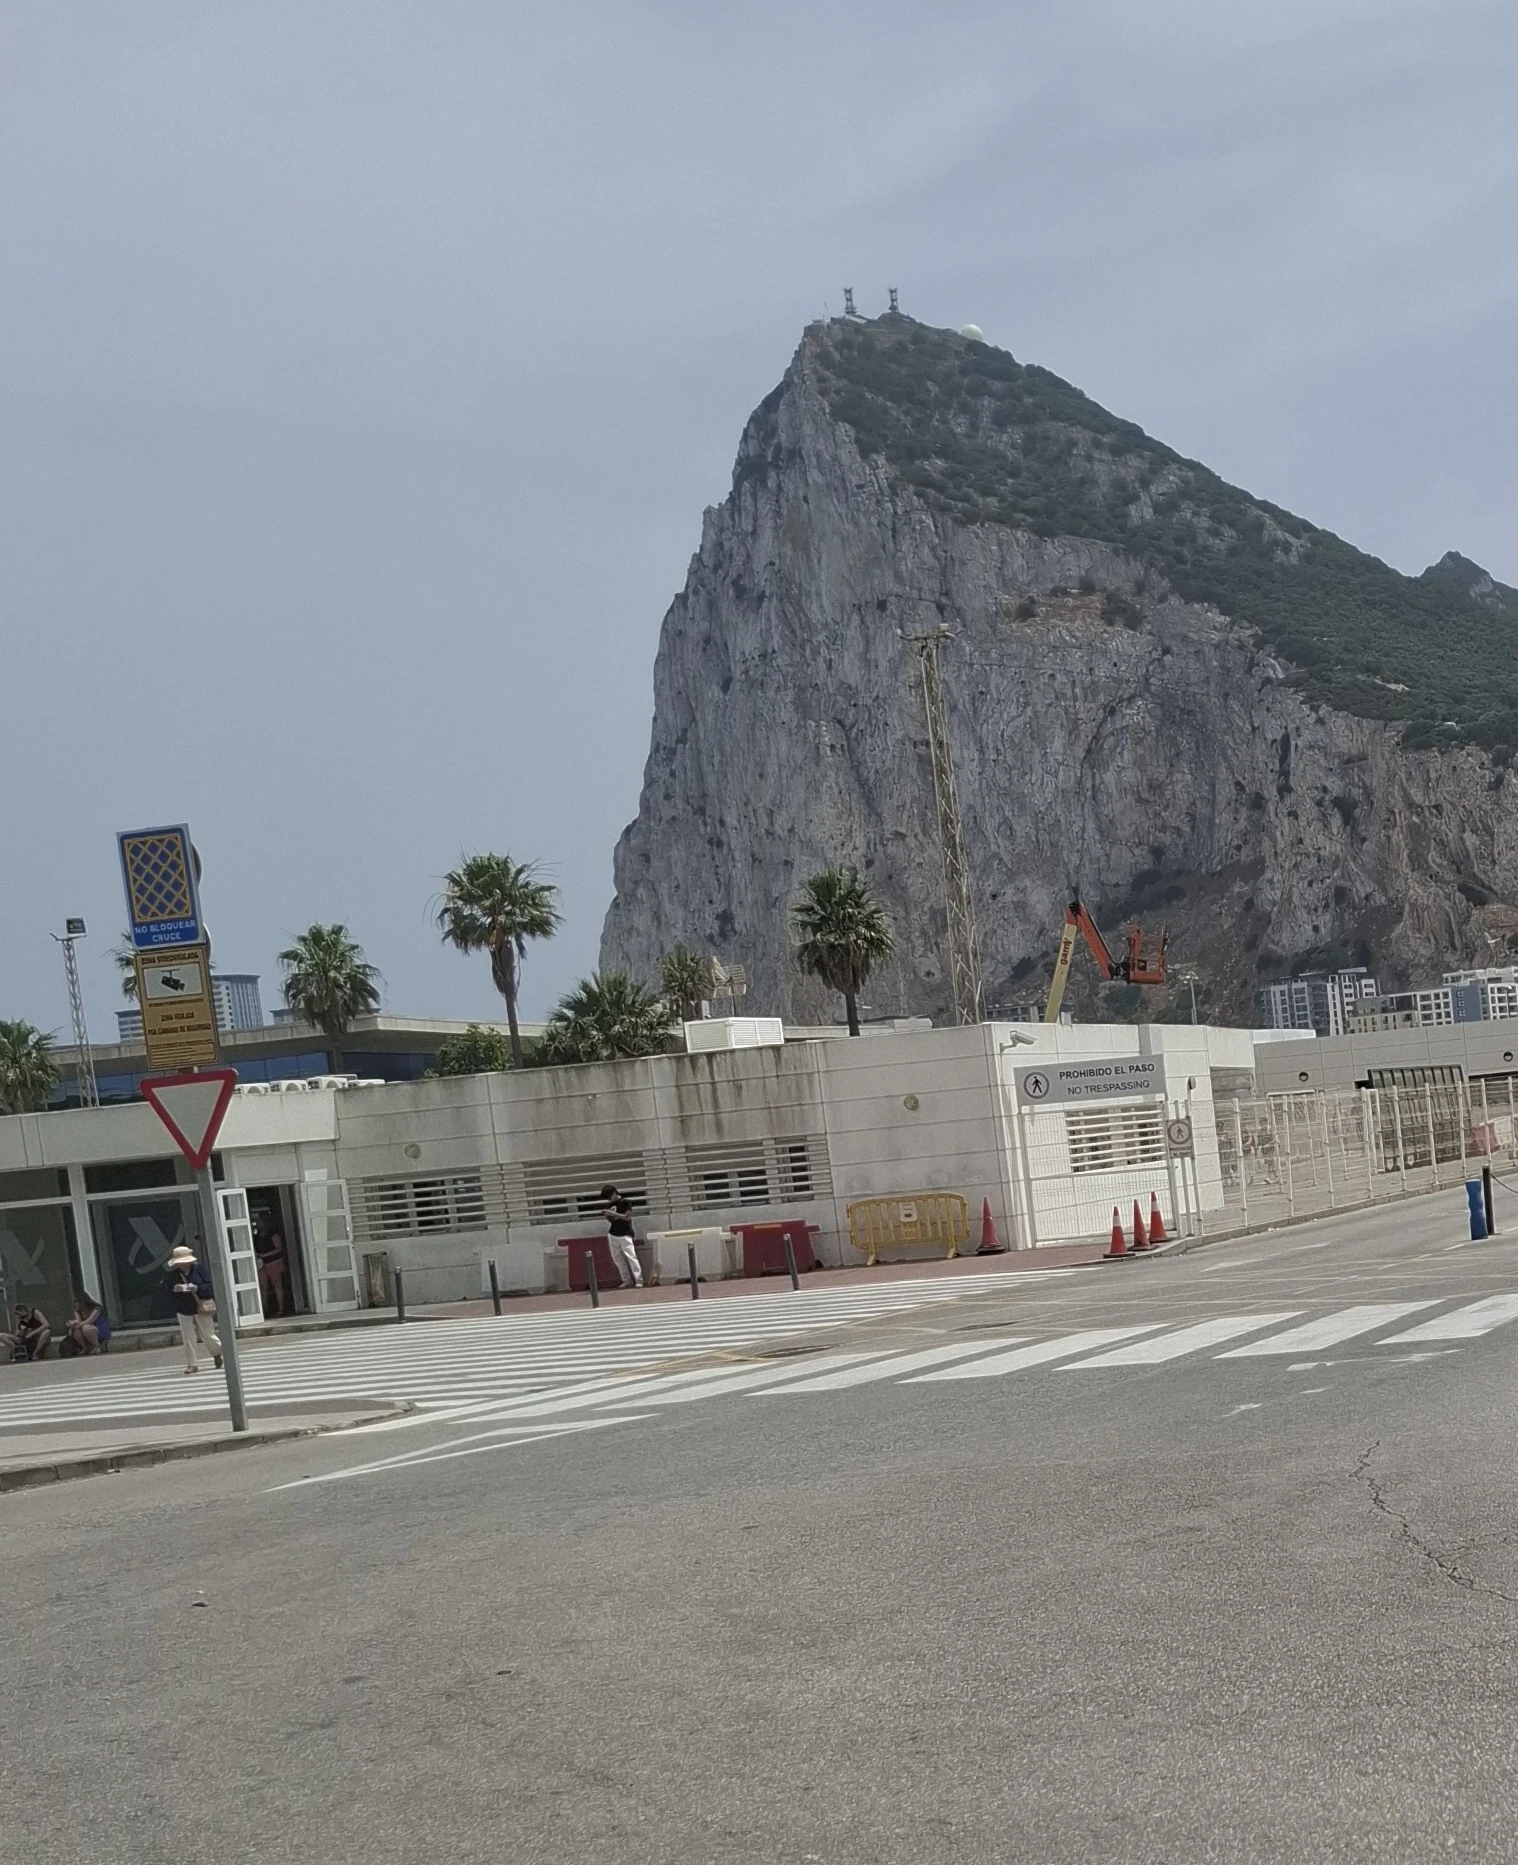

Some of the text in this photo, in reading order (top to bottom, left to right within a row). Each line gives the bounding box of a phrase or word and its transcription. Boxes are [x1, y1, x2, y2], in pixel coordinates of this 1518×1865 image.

[134, 920, 196, 934] NO BLOQUEAR
[152, 931, 182, 943] CRUCE
[1059, 1063, 1155, 1080] PROHIBIDO EL PASO
[1067, 1079, 1150, 1096] NO TRESPASSING
